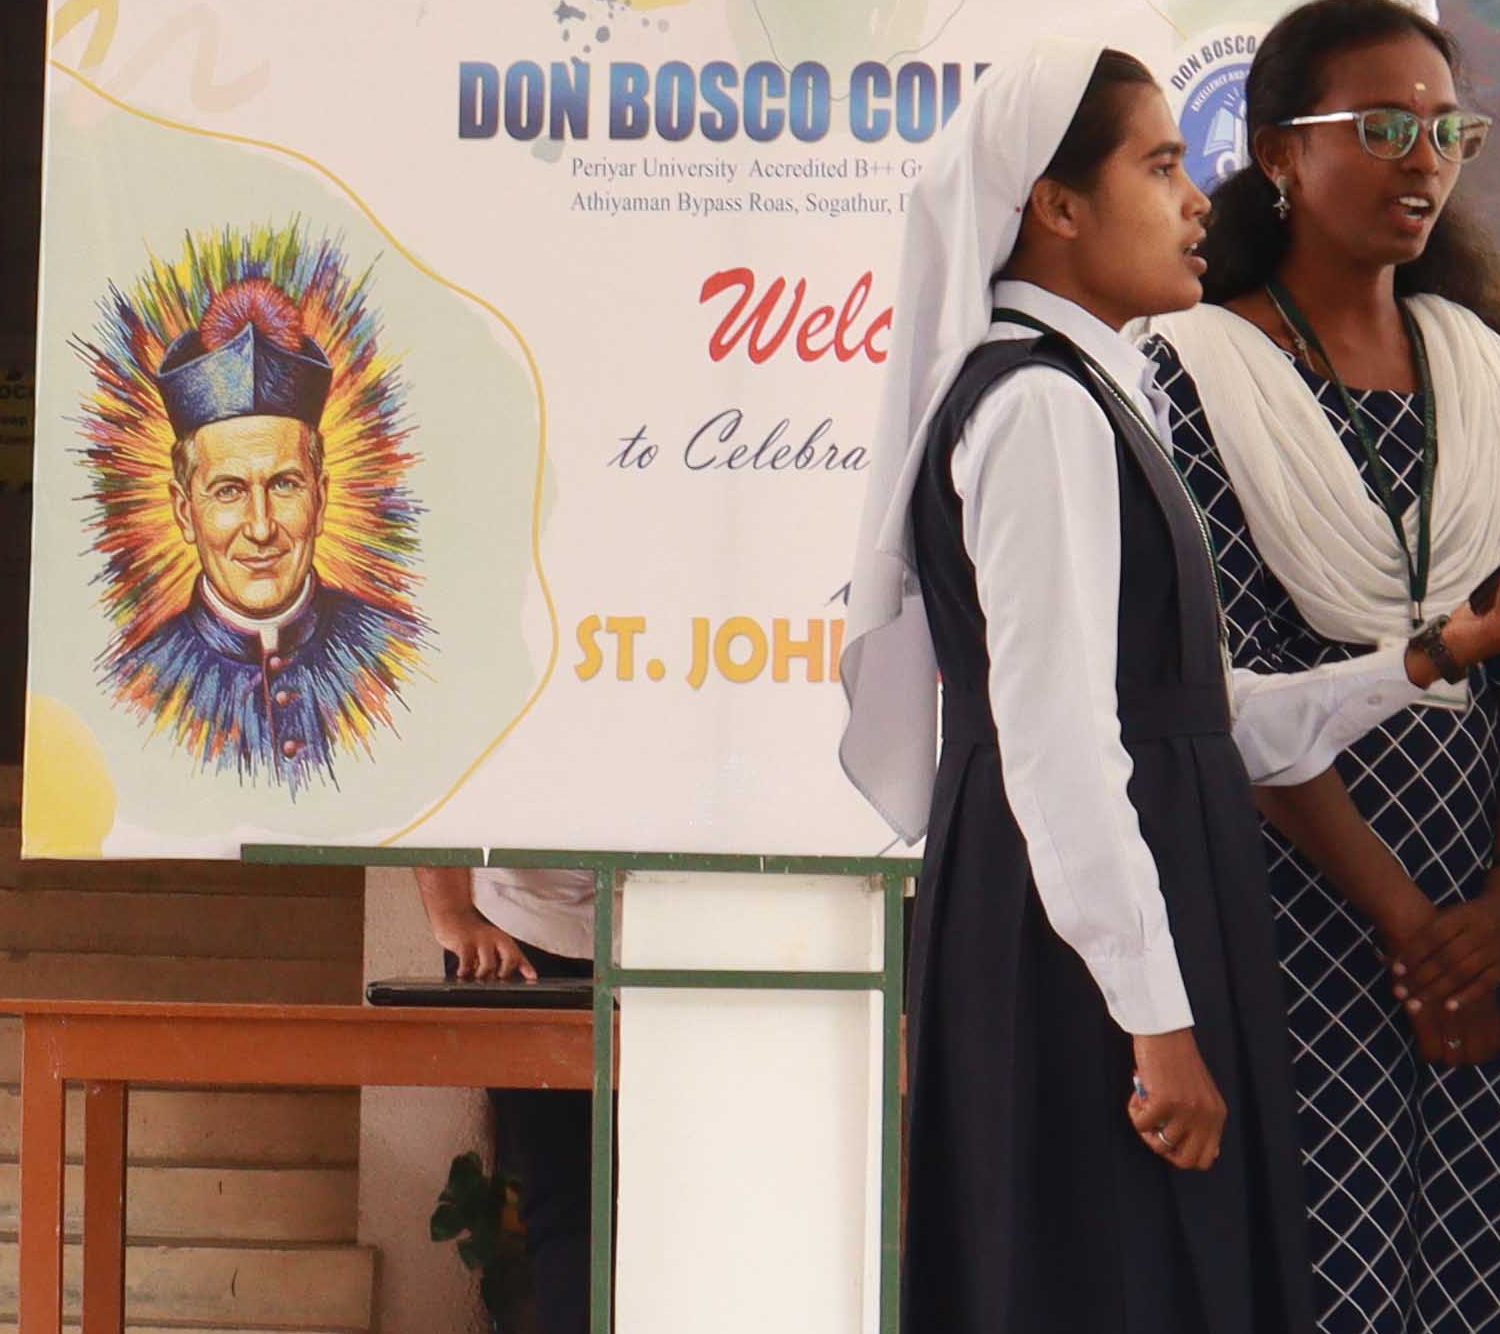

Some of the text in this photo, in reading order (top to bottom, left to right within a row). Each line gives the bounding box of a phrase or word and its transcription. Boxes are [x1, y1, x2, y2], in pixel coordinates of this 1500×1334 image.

[1169, 34, 1257, 92] DON BOSCO
[457, 59, 591, 142] DON
[608, 59, 832, 143] BOSCO
[570, 156, 639, 182] Periyar
[642, 156, 739, 182] University
[750, 156, 848, 179] Accredited
[855, 158, 895, 179] B++
[570, 190, 672, 218] Athiyaman
[677, 192, 744, 218] Bypass
[747, 192, 800, 216] Roas,
[805, 192, 893, 219] Sogathur,
[699, 266, 894, 365] Welc
[606, 408, 872, 472] to Celebra
[573, 613, 668, 685] ST.
